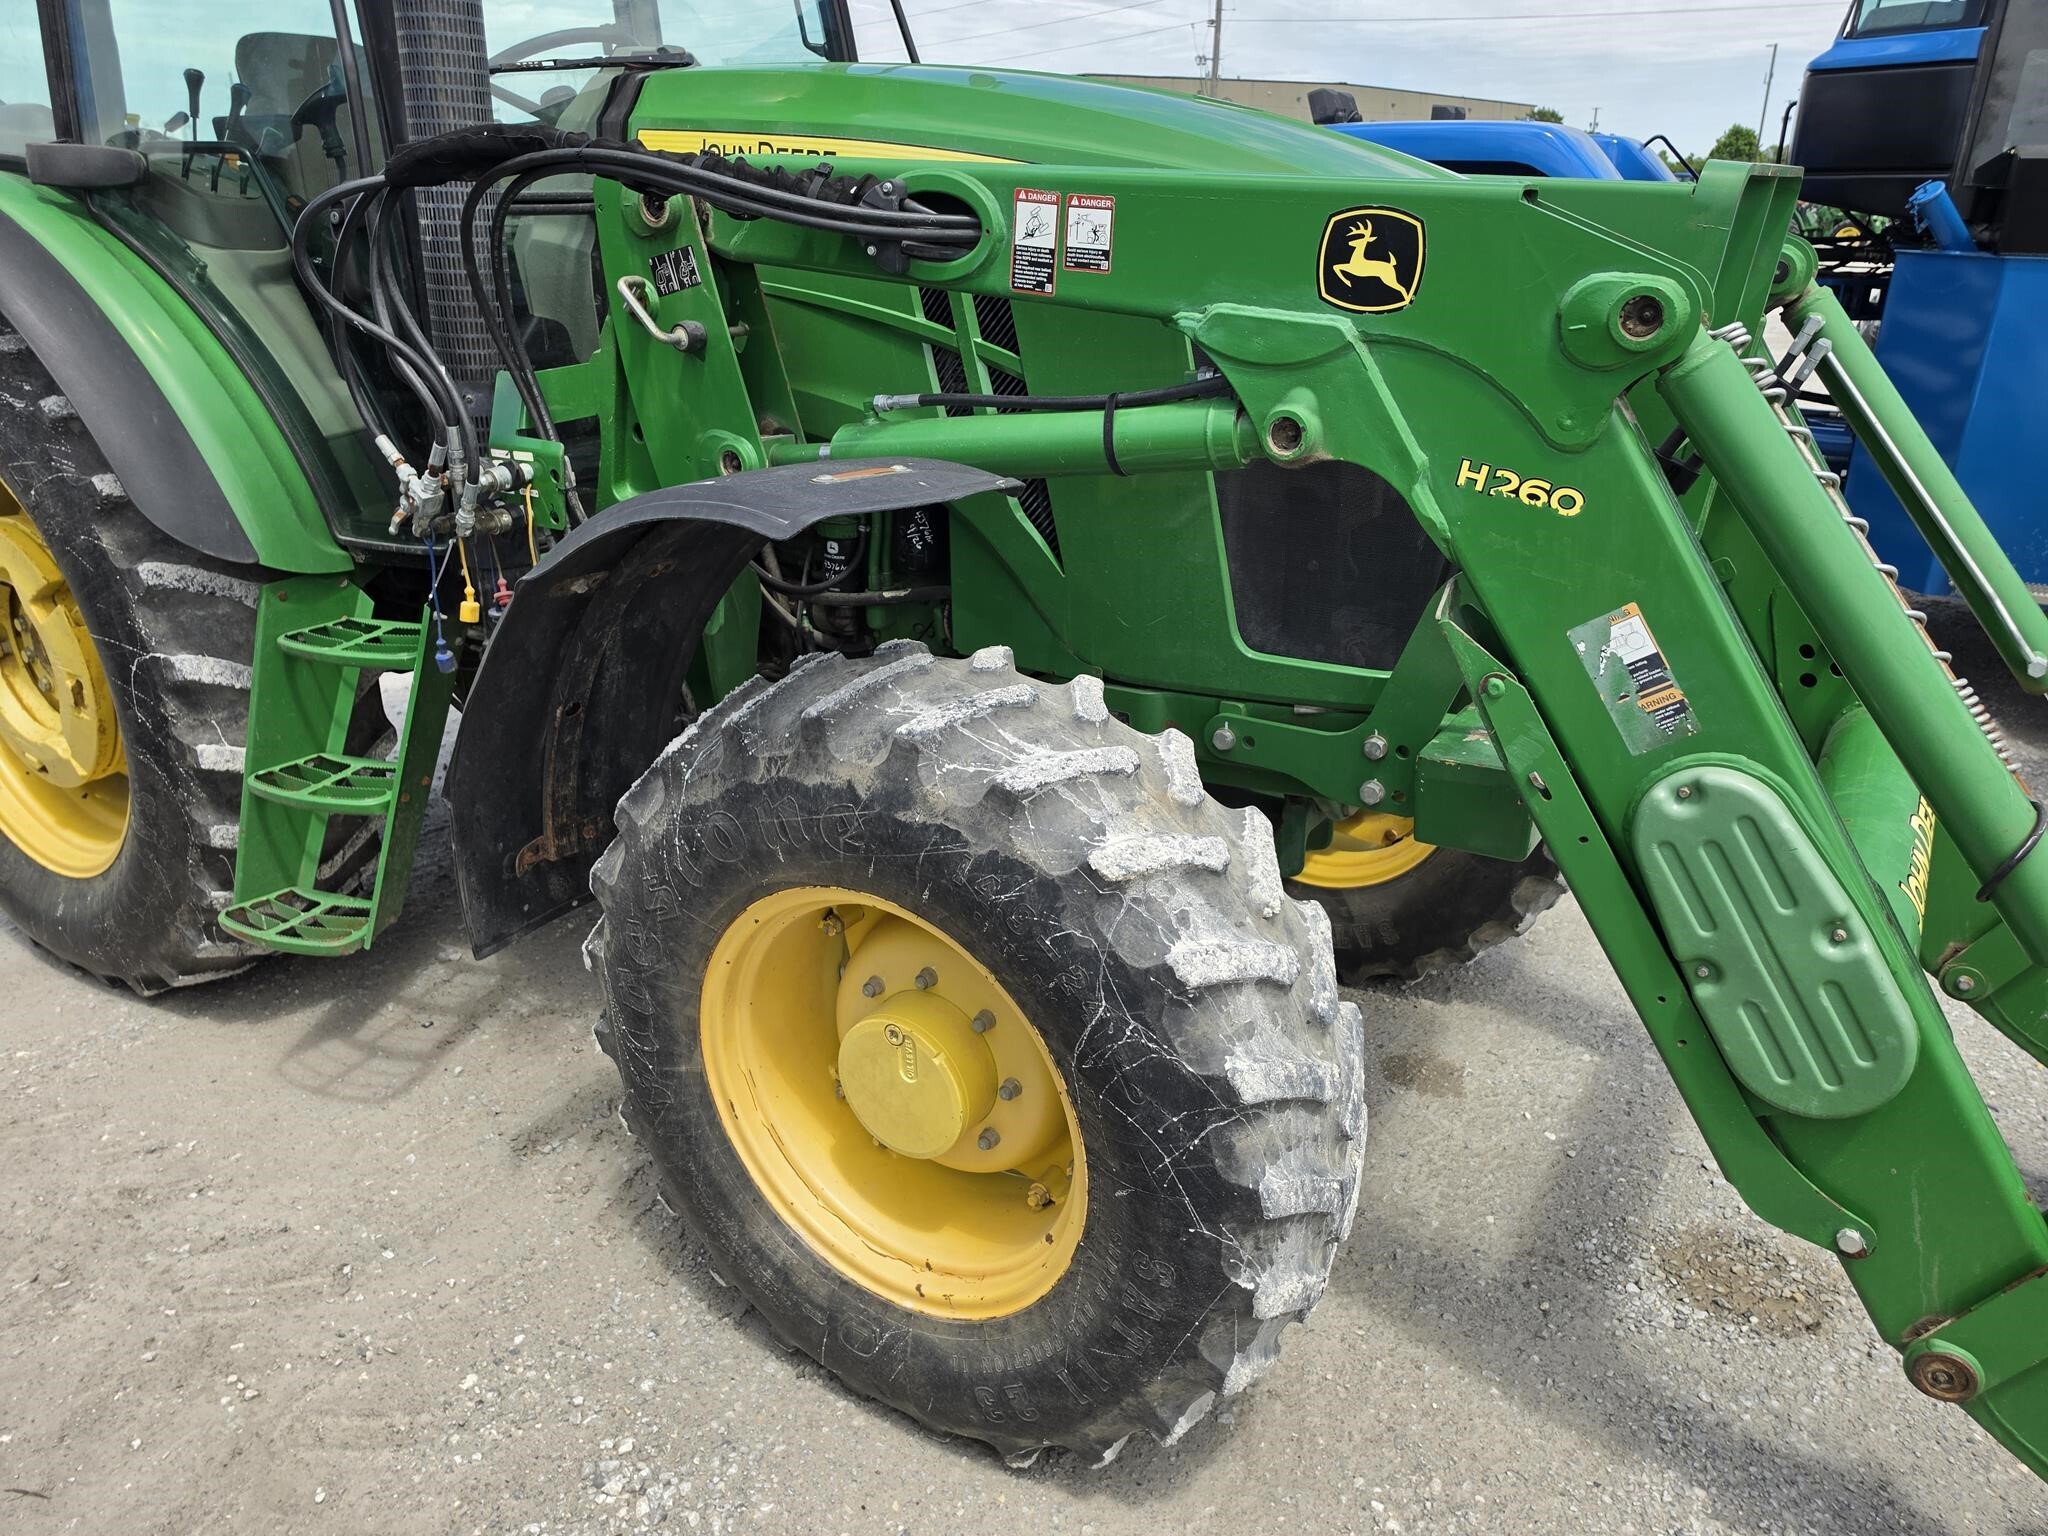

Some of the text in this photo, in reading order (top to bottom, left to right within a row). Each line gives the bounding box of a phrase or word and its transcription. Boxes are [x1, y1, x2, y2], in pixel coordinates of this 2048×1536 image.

[1027, 192, 1057, 202] DANGER
[1080, 198, 1112, 208] DANGER
[1456, 458, 1585, 516] H260
[1640, 693, 1676, 710] ARNING
[1112, 1249, 1176, 1356] SAT
